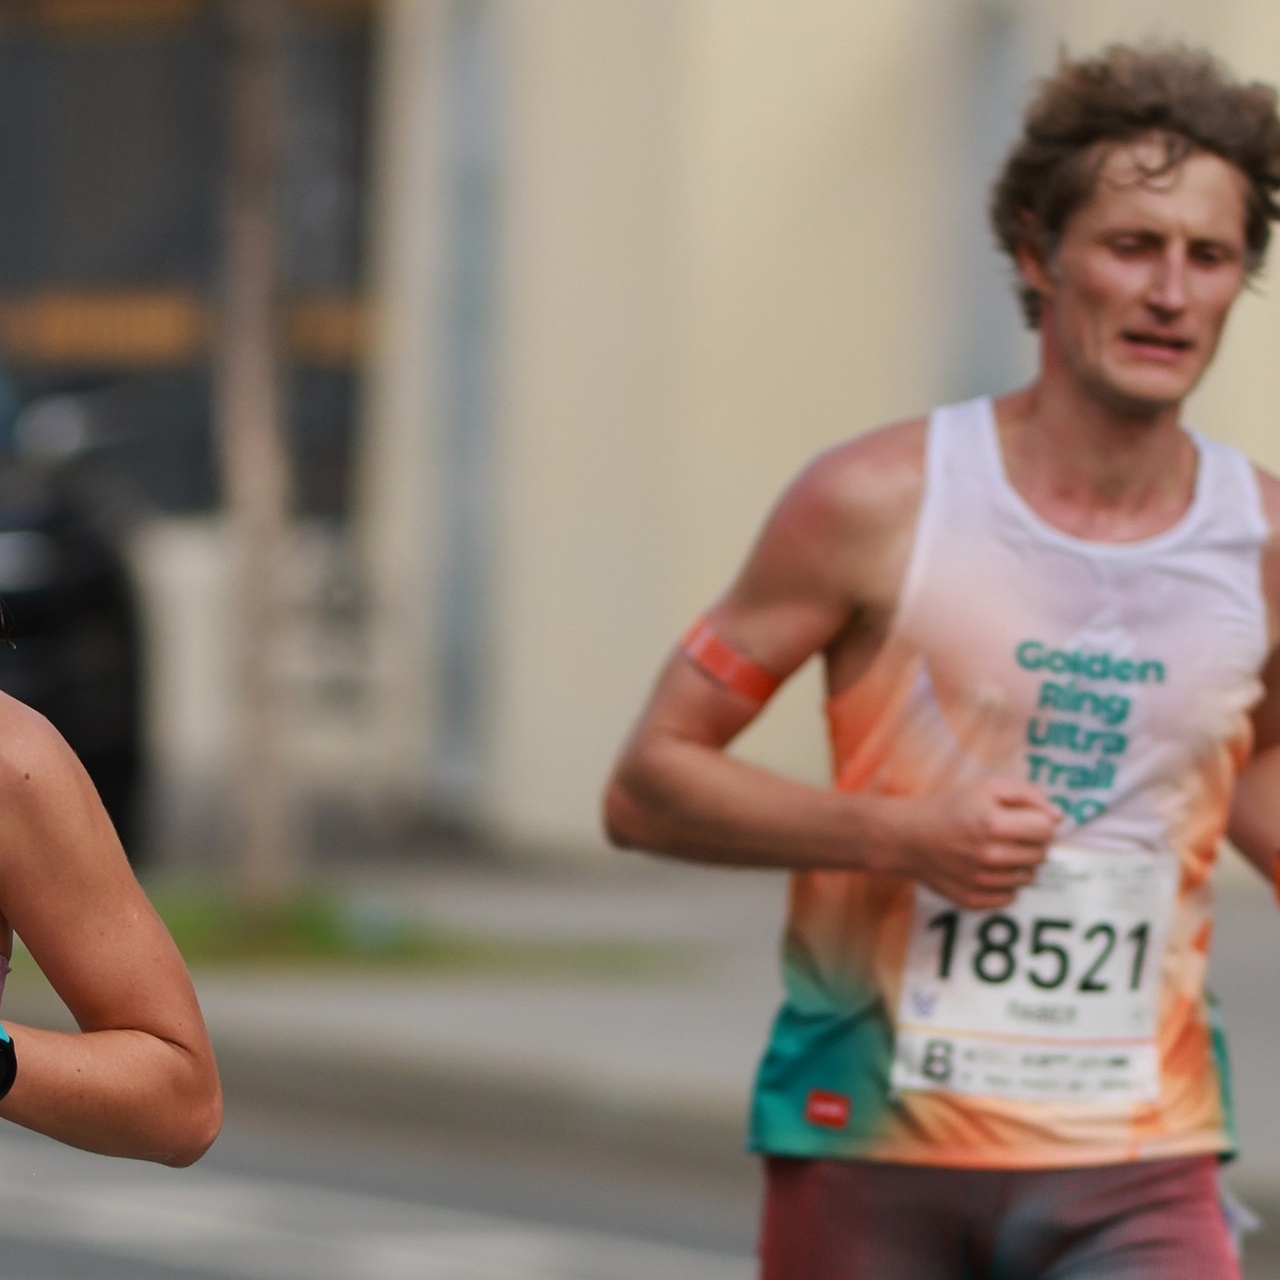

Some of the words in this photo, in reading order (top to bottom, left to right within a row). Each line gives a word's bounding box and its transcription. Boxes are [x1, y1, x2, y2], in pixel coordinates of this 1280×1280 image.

[1016, 640, 1165, 684] Golden
[1038, 681, 1130, 726] Ring
[1027, 718, 1128, 755] Ultra
[1028, 754, 1117, 789] Trail
[927, 908, 1151, 992] 18521
